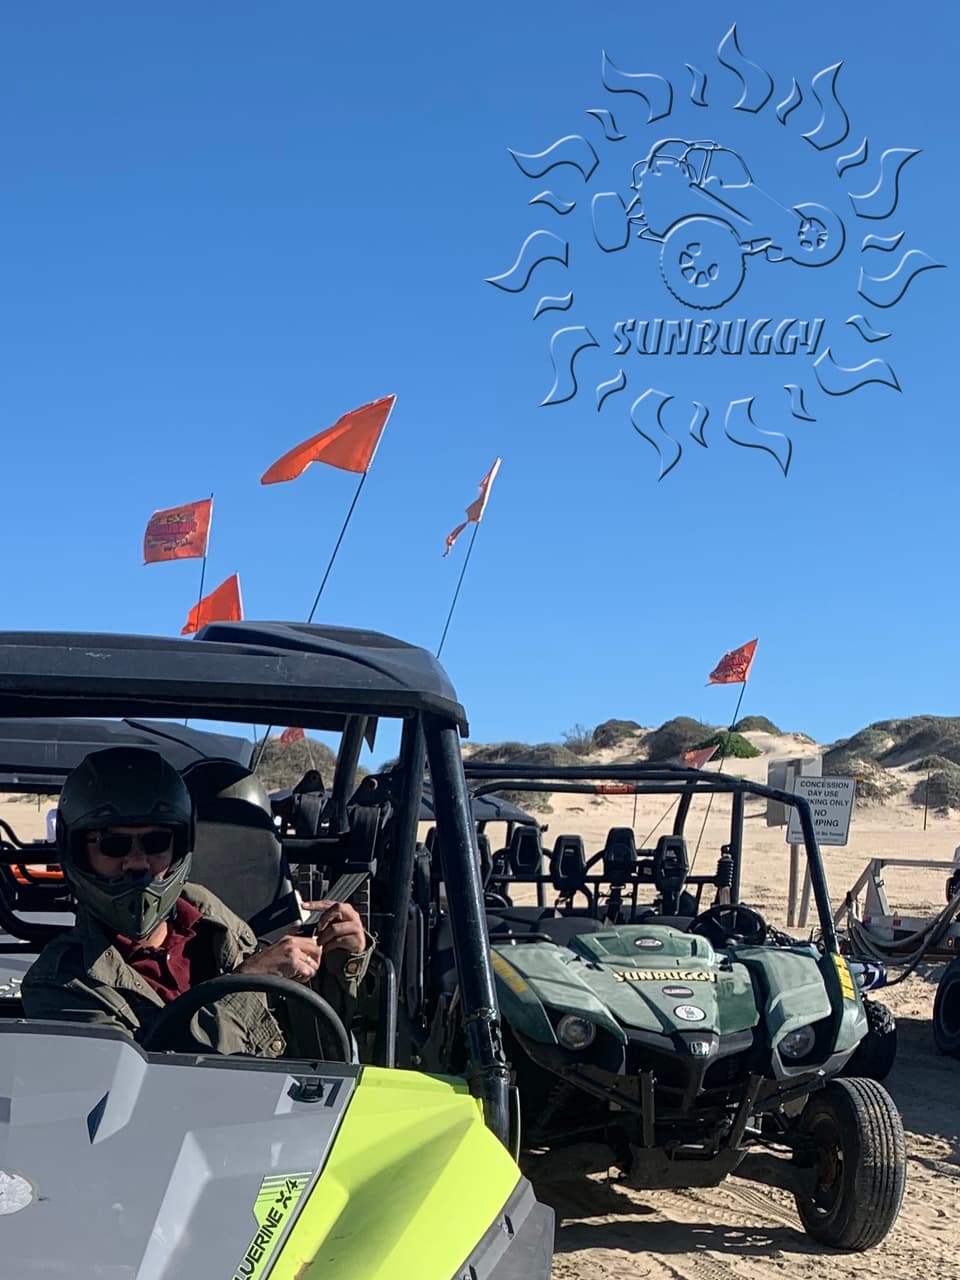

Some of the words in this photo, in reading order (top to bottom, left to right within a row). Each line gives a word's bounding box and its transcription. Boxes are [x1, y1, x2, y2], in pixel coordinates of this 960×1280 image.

[800, 780, 849, 789] CONCESSION
[824, 790, 839, 798] USE
[830, 799, 850, 807] ONLY
[814, 809, 828, 817] NO
